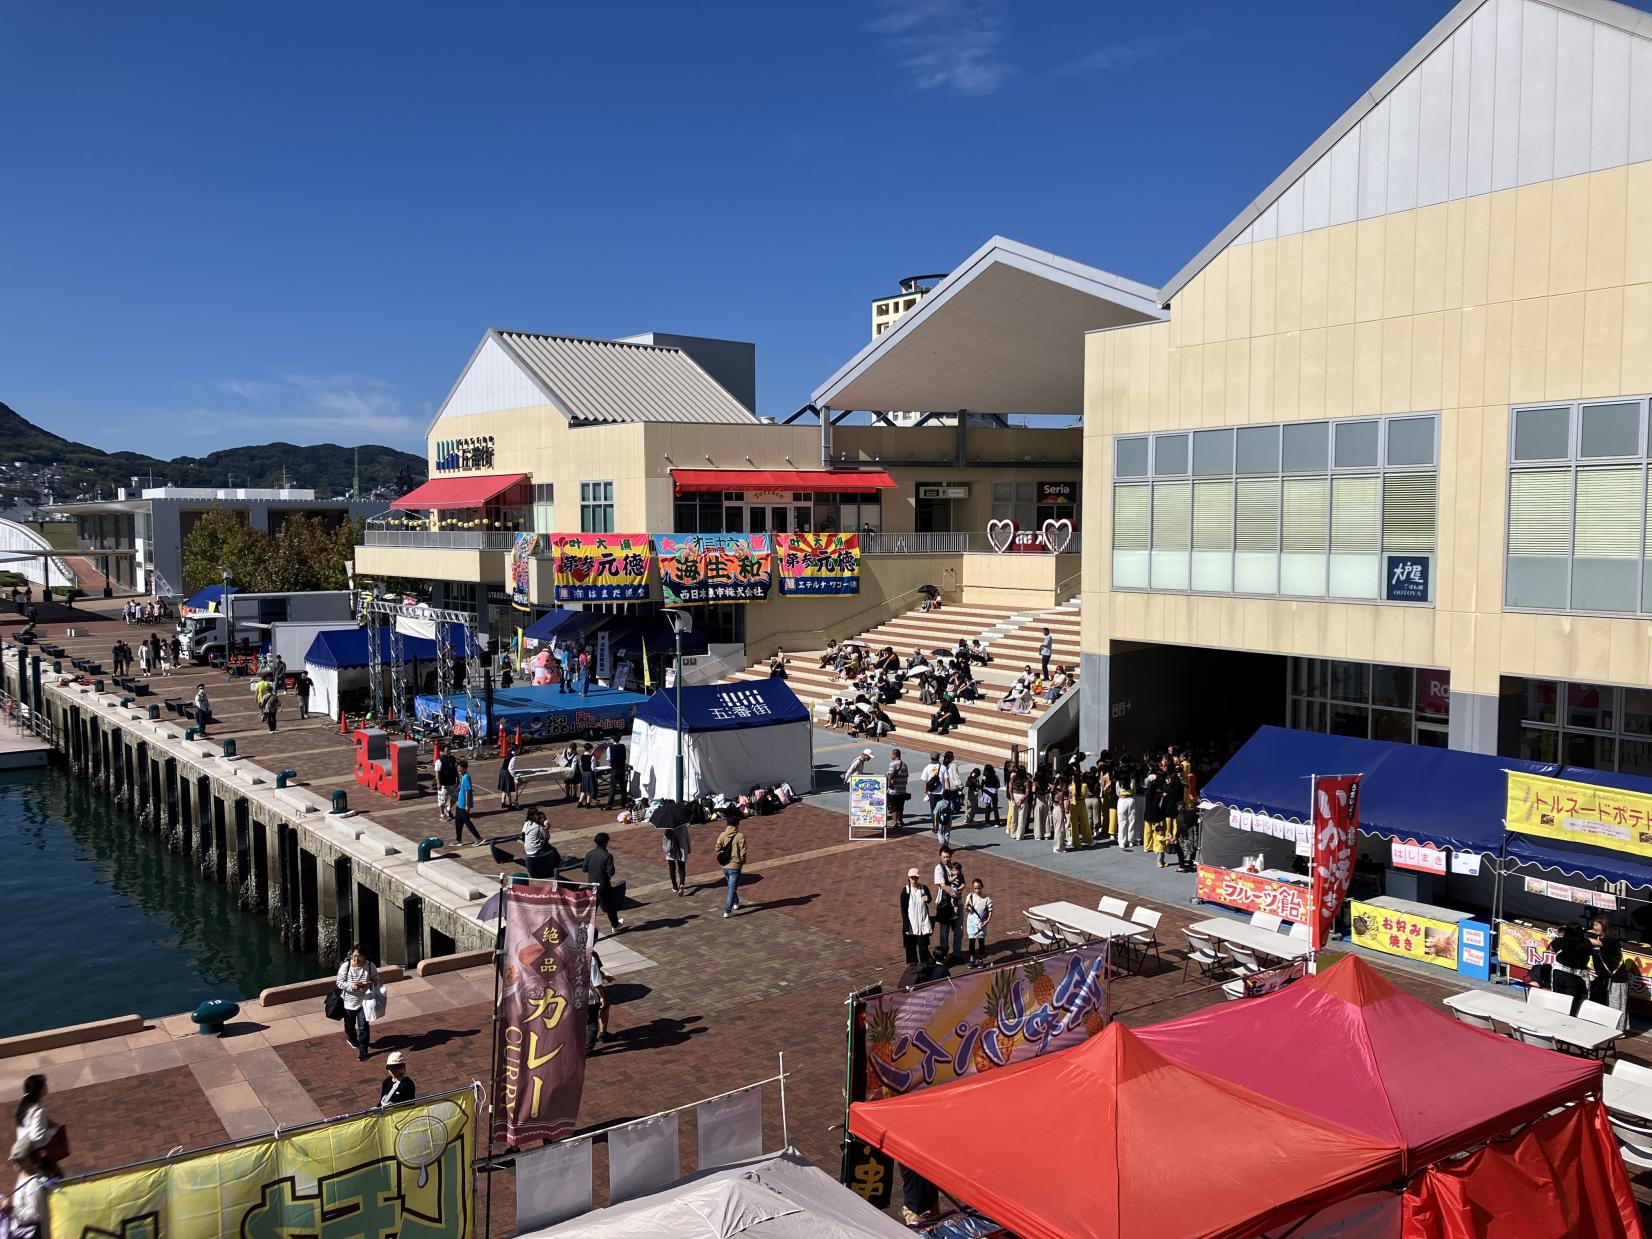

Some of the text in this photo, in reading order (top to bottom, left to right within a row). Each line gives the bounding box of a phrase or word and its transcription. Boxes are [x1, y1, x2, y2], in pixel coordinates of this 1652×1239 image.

[1043, 484, 1070, 494] Seria
[1392, 561, 1424, 585] 大戸屋
[708, 703, 772, 720] 五番街
[1535, 791, 1652, 831] トルネードポテト
[1394, 848, 1442, 866] はしまき
[1222, 881, 1303, 920] フルーツ飴
[1382, 917, 1422, 937] お好み
[540, 927, 560, 973] 絶品
[1389, 934, 1413, 952] 焼き
[523, 987, 567, 1119] カレー
[500, 1025, 523, 1119] CURRY
